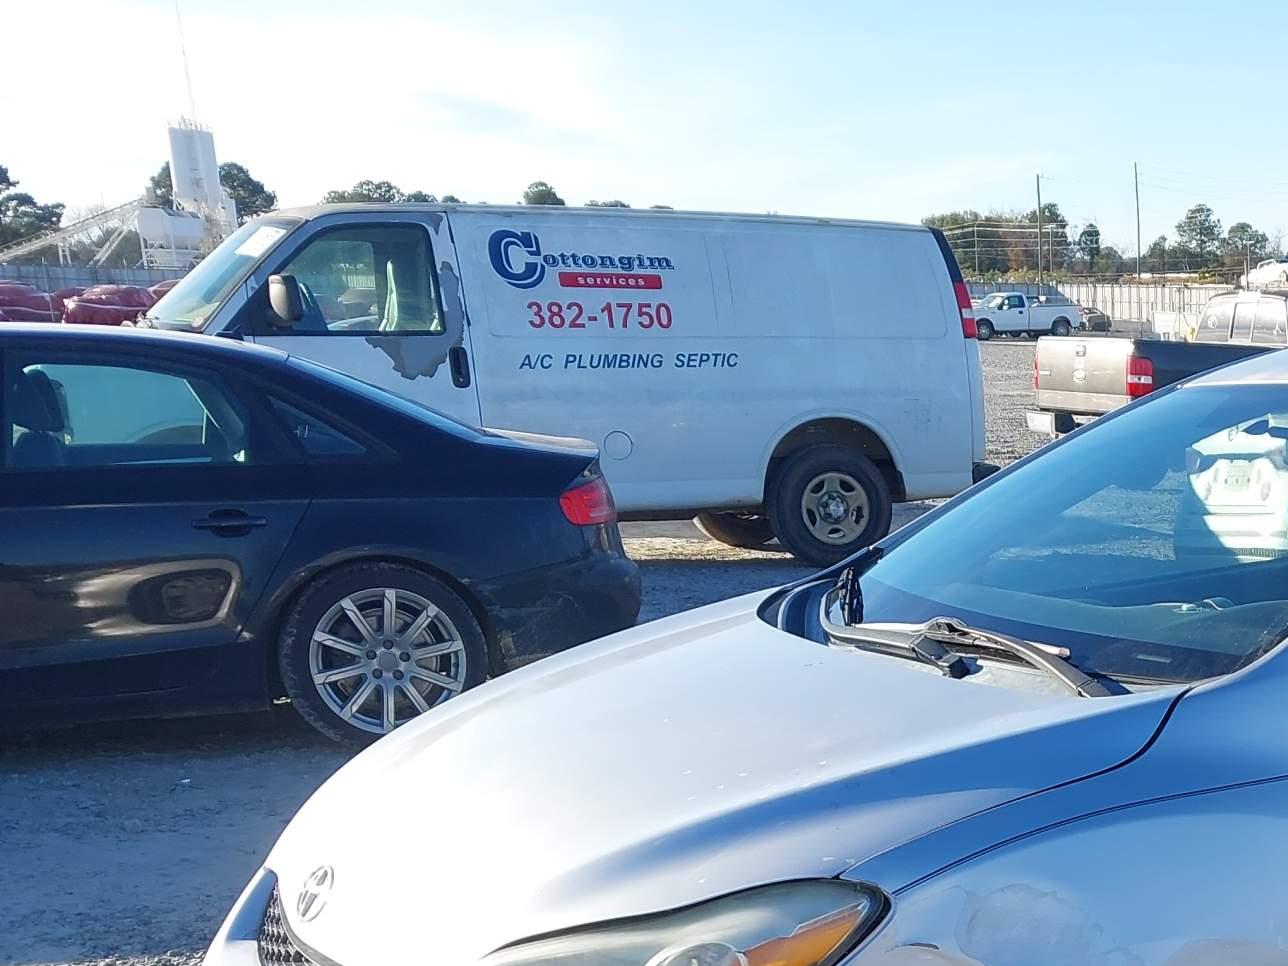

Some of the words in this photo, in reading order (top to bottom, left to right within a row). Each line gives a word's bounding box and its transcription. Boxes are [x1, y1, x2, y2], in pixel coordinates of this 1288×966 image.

[487, 229, 674, 289] Cottongim
[576, 275, 645, 287] services
[526, 302, 672, 329] 382-1750
[519, 354, 553, 370] A/C
[563, 354, 663, 369] PLUMBING
[674, 352, 738, 368] SEPTIC
